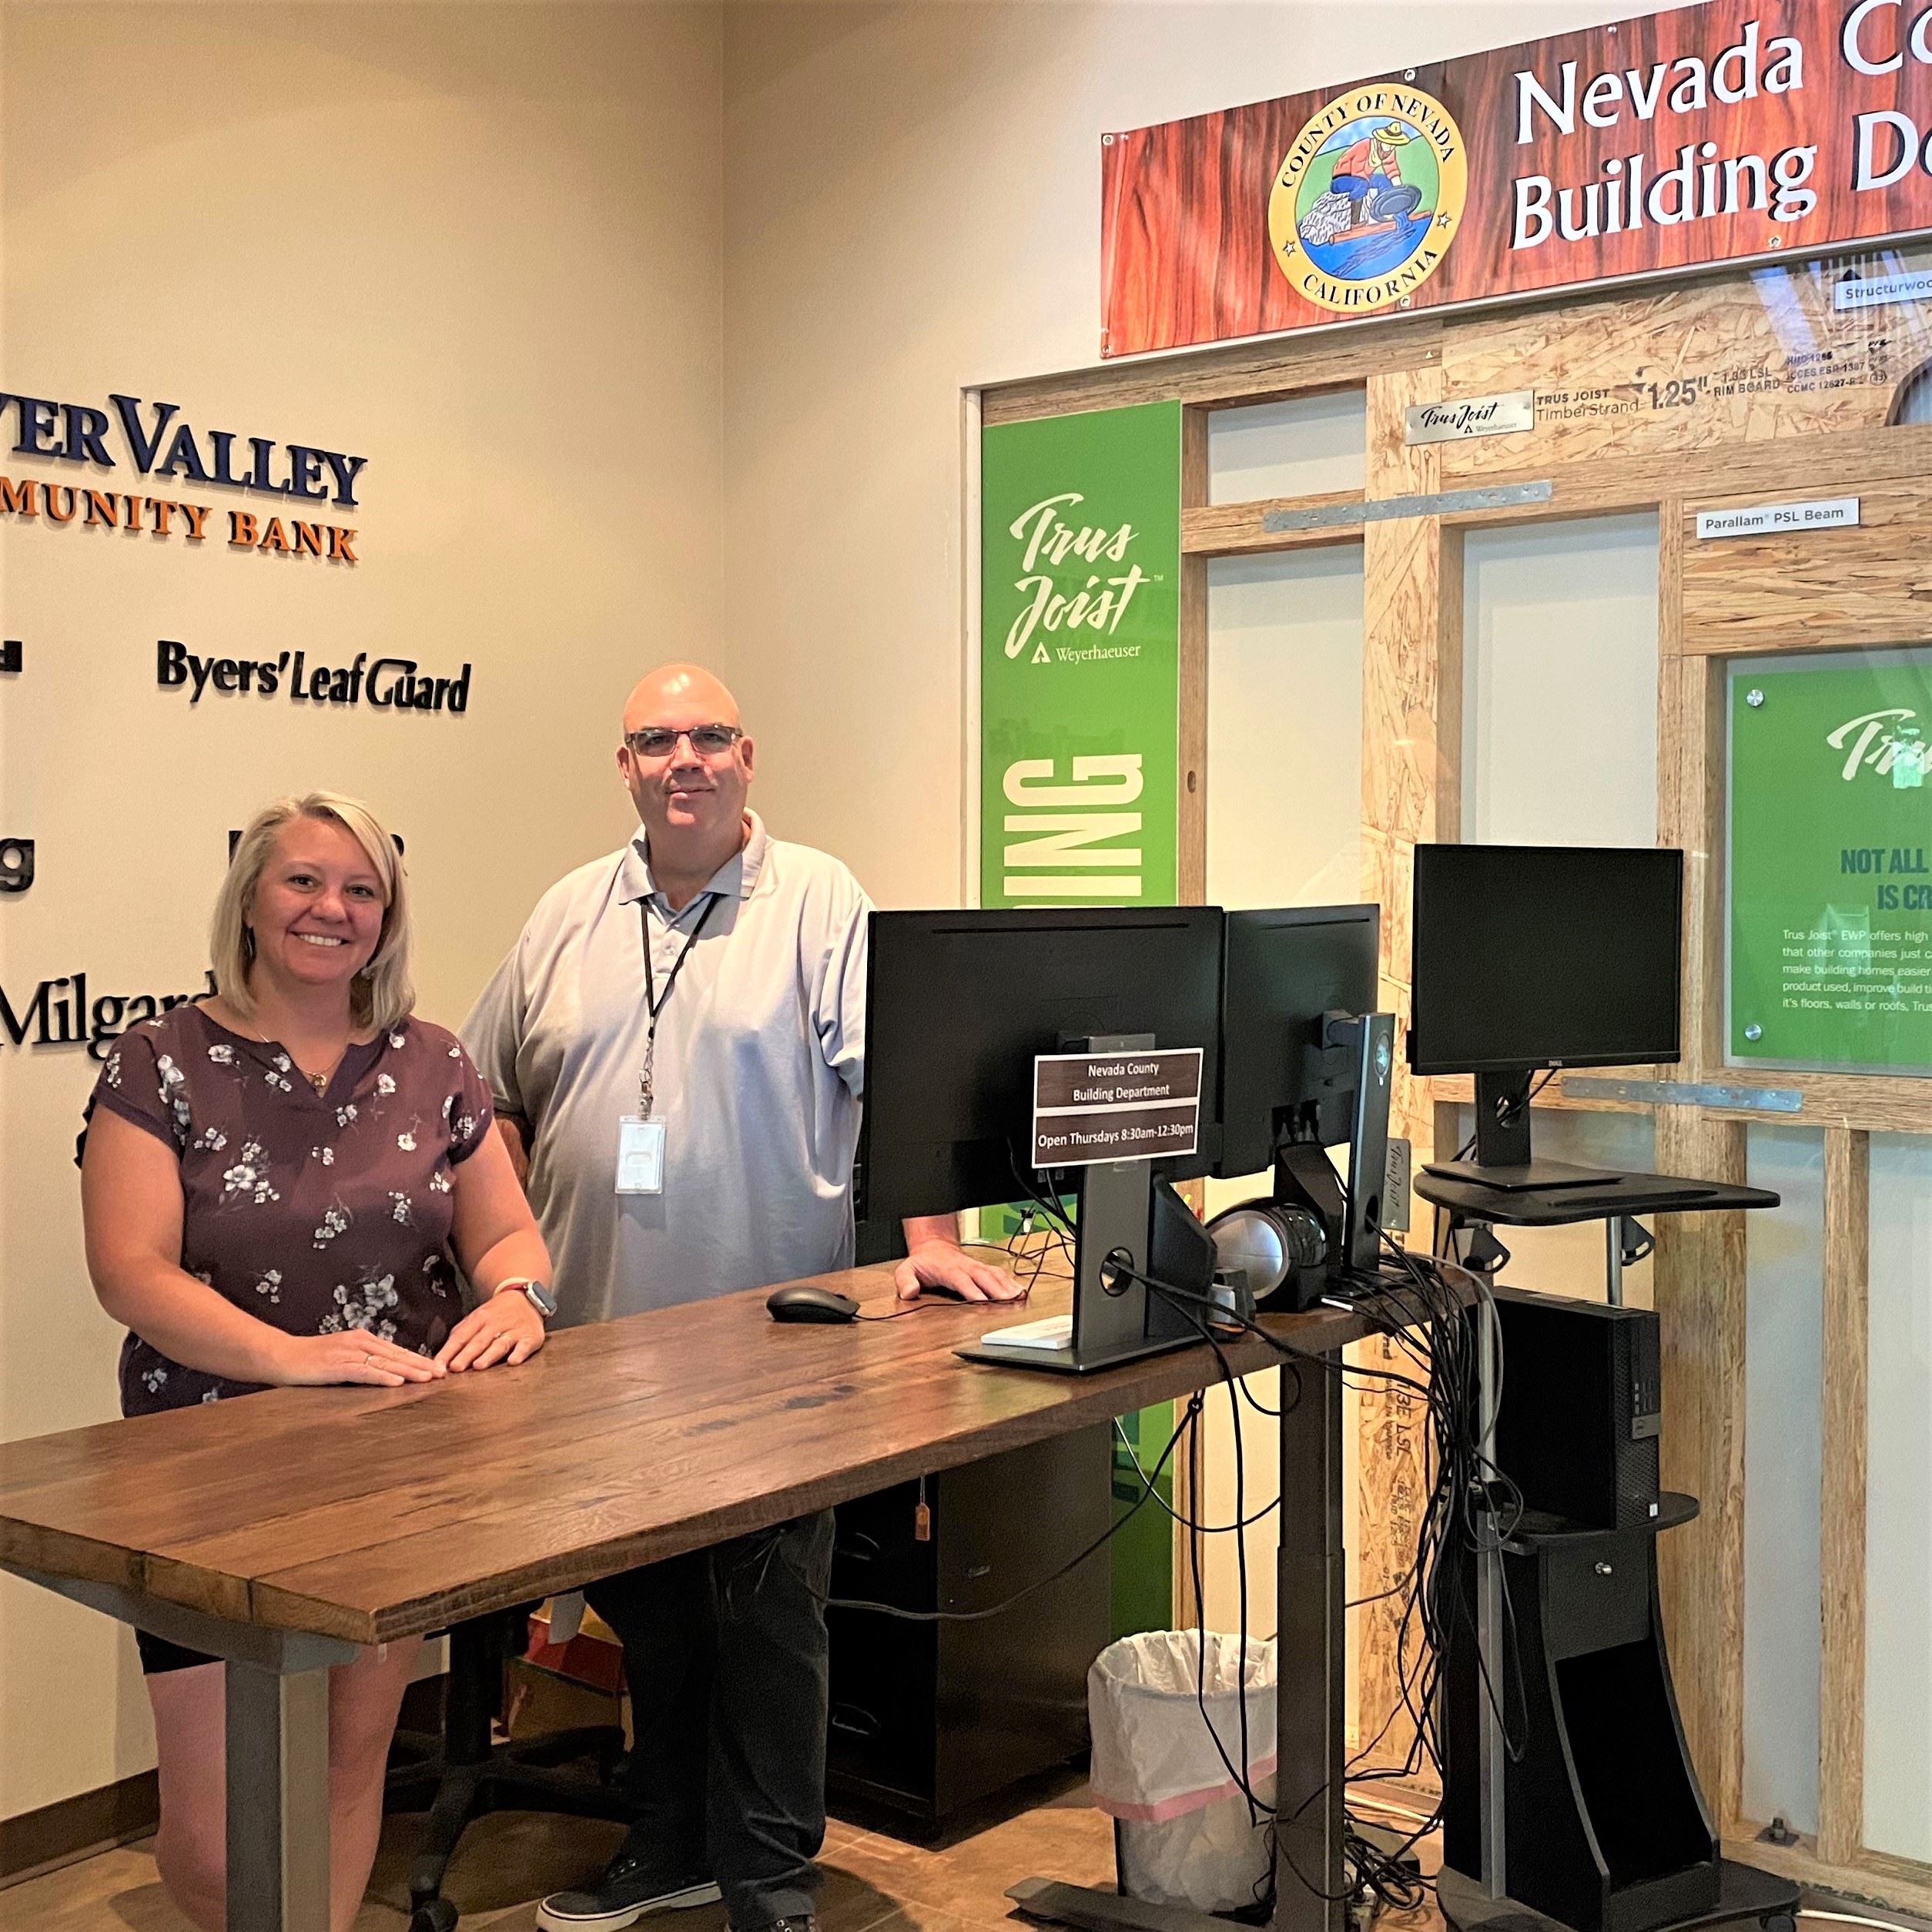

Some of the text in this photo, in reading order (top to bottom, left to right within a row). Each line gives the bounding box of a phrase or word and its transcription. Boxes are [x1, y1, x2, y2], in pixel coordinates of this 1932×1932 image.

[1513, 21, 1803, 145] Nevada
[1281, 93, 1455, 188] COUNTY OF NEVADA
[1509, 110, 1932, 250] Building D
[1303, 248, 1438, 306] CALIFORNIA
[1750, 367, 1773, 379] LSL
[1536, 393, 1569, 406] TRUS
[1572, 389, 1611, 402] JOIST
[1713, 379, 1781, 397] RIM BOARD
[1535, 397, 1640, 421] TimberStrand
[1773, 512, 1800, 524] PSL
[1804, 507, 1844, 521] Beam
[227, 510, 359, 561] BANK
[1010, 493, 1140, 572] Trus
[1004, 564, 1151, 659] Joist
[1055, 644, 1141, 665] Weyerhaeuser
[1840, 848, 1930, 874] NOT ALL
[1877, 884, 1900, 910] IS
[1782, 929, 1805, 940] Trus
[1840, 929, 1867, 941] EWP
[1869, 930, 1901, 941] offers
[1904, 930, 1929, 943] high
[1782, 947, 1803, 957] that
[1806, 947, 1834, 958] other
[1837, 948, 1897, 961] companies
[1899, 948, 1921, 961] just
[1782, 964, 1932, 977] make building homes easier
[1782, 982, 1822, 994] product
[1823, 982, 1852, 993] used,
[1853, 983, 1896, 996] improve
[1896, 983, 1923, 994] build
[1782, 997, 1798, 1008] it's
[1835, 999, 1862, 1010] walls
[1864, 1001, 1877, 1010] or
[1087, 1062, 1160, 1077] Nevada County
[1073, 1084, 1170, 1103] Building Department
[1037, 1134, 1067, 1149] Open
[1070, 1130, 1119, 1145] Thursdays
